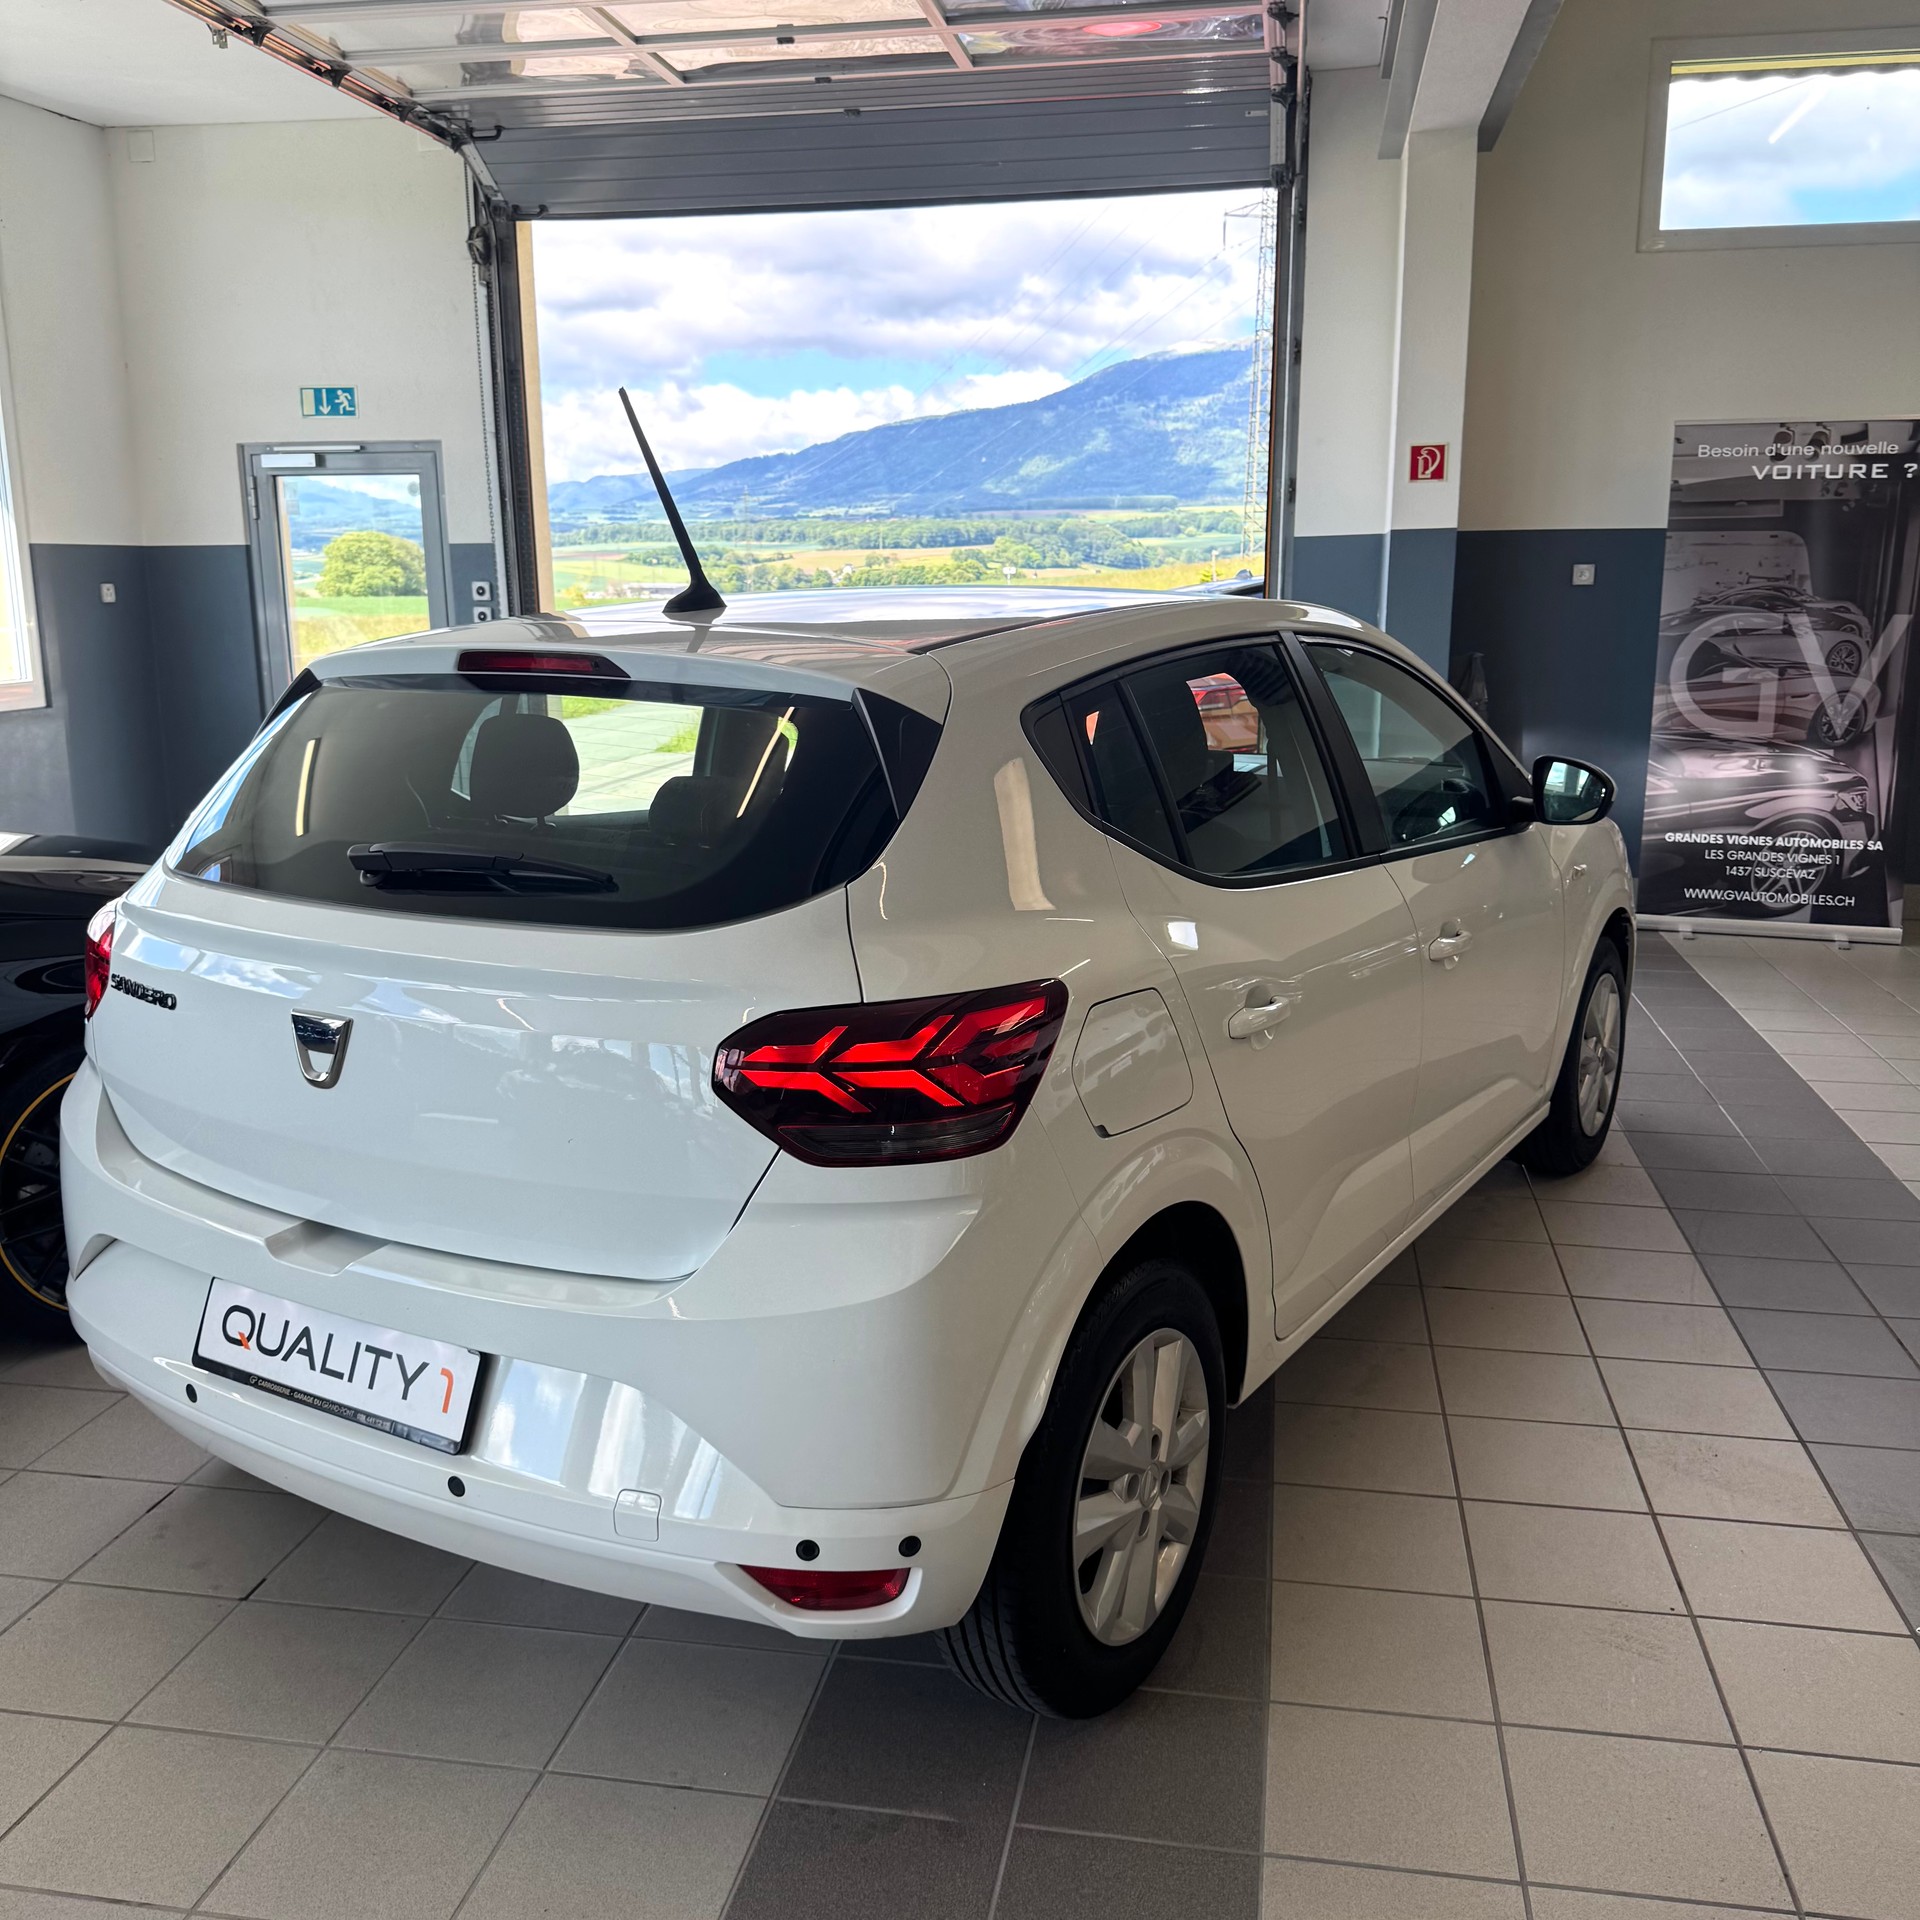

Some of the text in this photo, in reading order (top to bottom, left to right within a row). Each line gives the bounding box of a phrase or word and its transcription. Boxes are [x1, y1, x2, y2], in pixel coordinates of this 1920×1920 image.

[1697, 441, 1899, 458] Besoin d'une nouvelle
[1752, 462, 1918, 480] VOITURE ?
[1669, 611, 1913, 739] GV
[1664, 832, 1884, 851] GRANDES VIGNES AUTOMOBILES SA
[1704, 849, 1841, 865] LES GRANDES VIGNES 1
[1725, 865, 1752, 876] 1437
[1683, 887, 1856, 907] WWW.GVAUTOMOBILES.CH
[110, 973, 178, 1011] SANDERO
[221, 1304, 455, 1415] QUALITY 1
[293, 1391, 314, 1404] GARAGE
